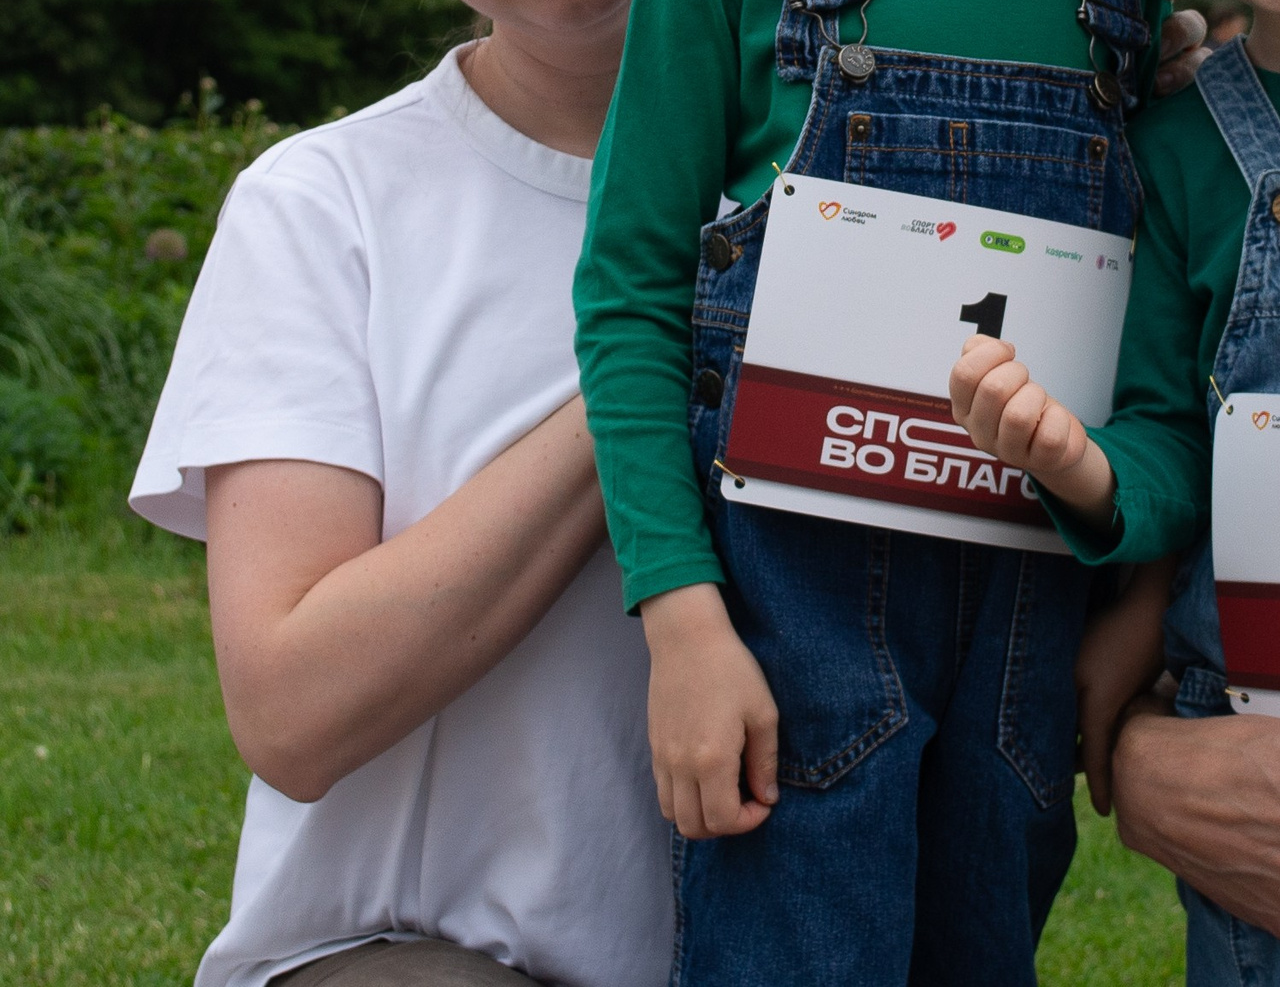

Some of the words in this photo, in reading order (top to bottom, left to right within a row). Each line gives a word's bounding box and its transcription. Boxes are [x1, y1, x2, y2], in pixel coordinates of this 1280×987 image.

[911, 219, 936, 229] СПОРТ
[1045, 245, 1083, 263] kaspersky
[826, 405, 998, 461] СПО
[820, 436, 895, 475] ВО
